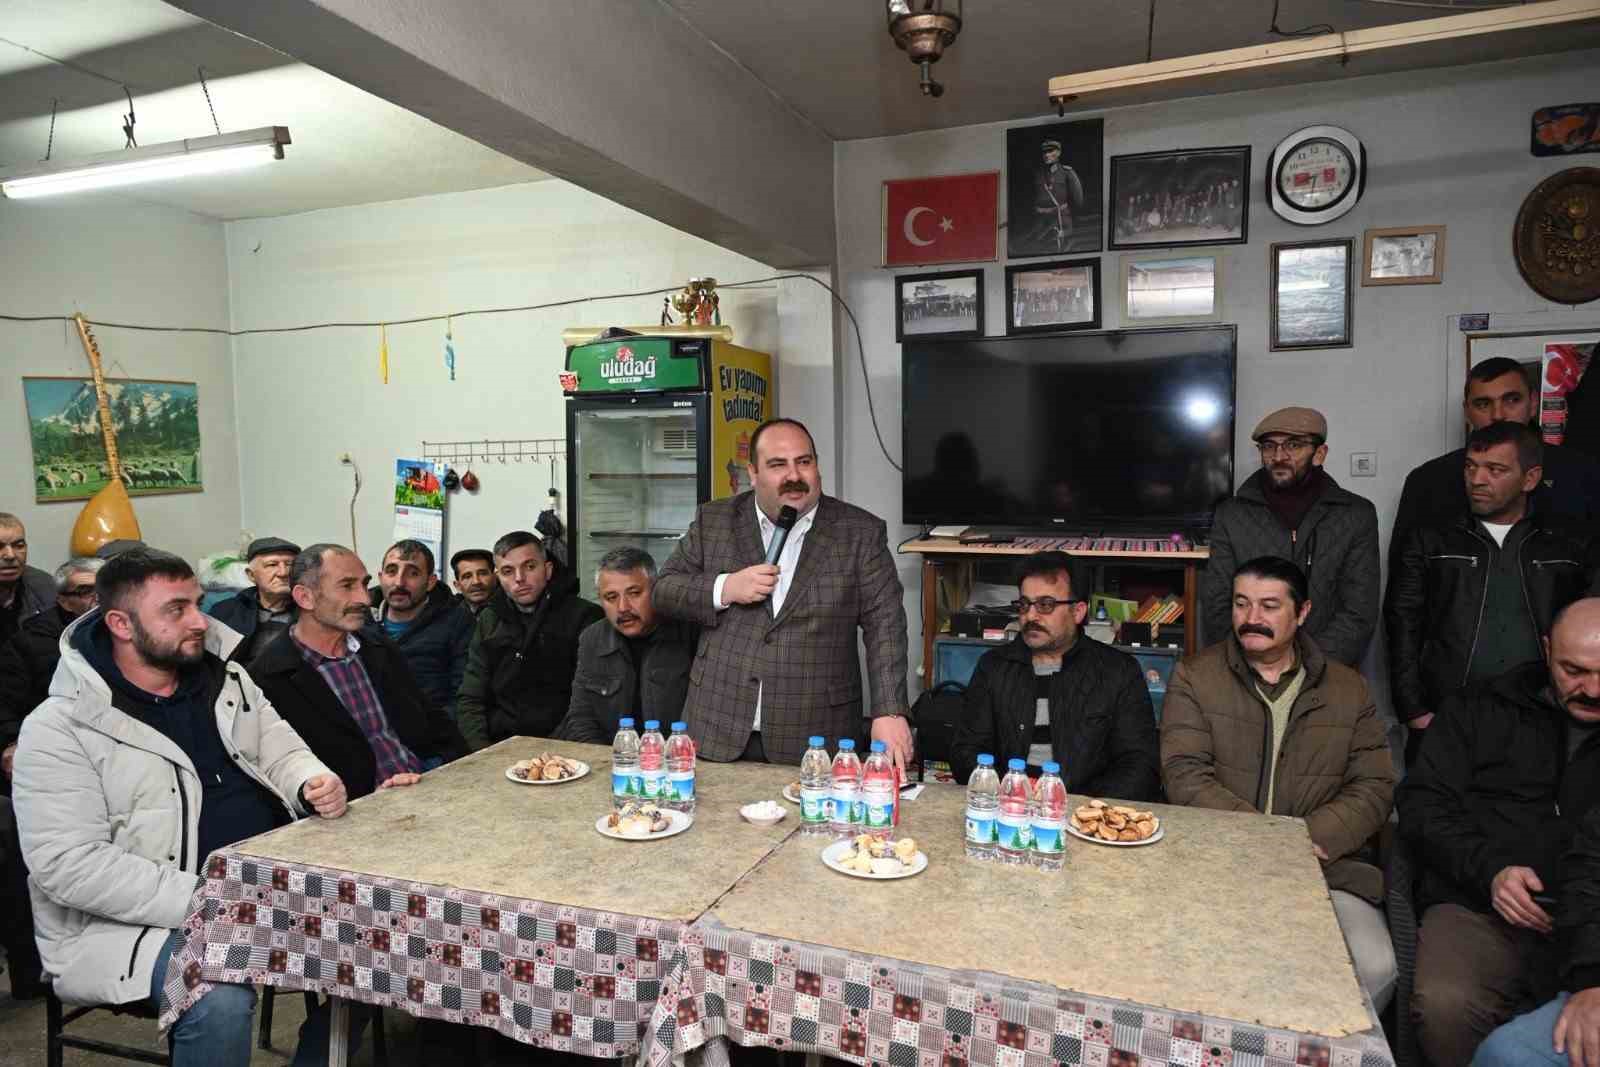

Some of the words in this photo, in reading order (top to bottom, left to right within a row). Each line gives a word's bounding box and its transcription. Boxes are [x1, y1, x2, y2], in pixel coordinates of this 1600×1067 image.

[601, 356, 656, 378] uludağ
[719, 365, 732, 391] Ev
[734, 367, 767, 397] yapımı
[722, 394, 764, 423] tadında!
